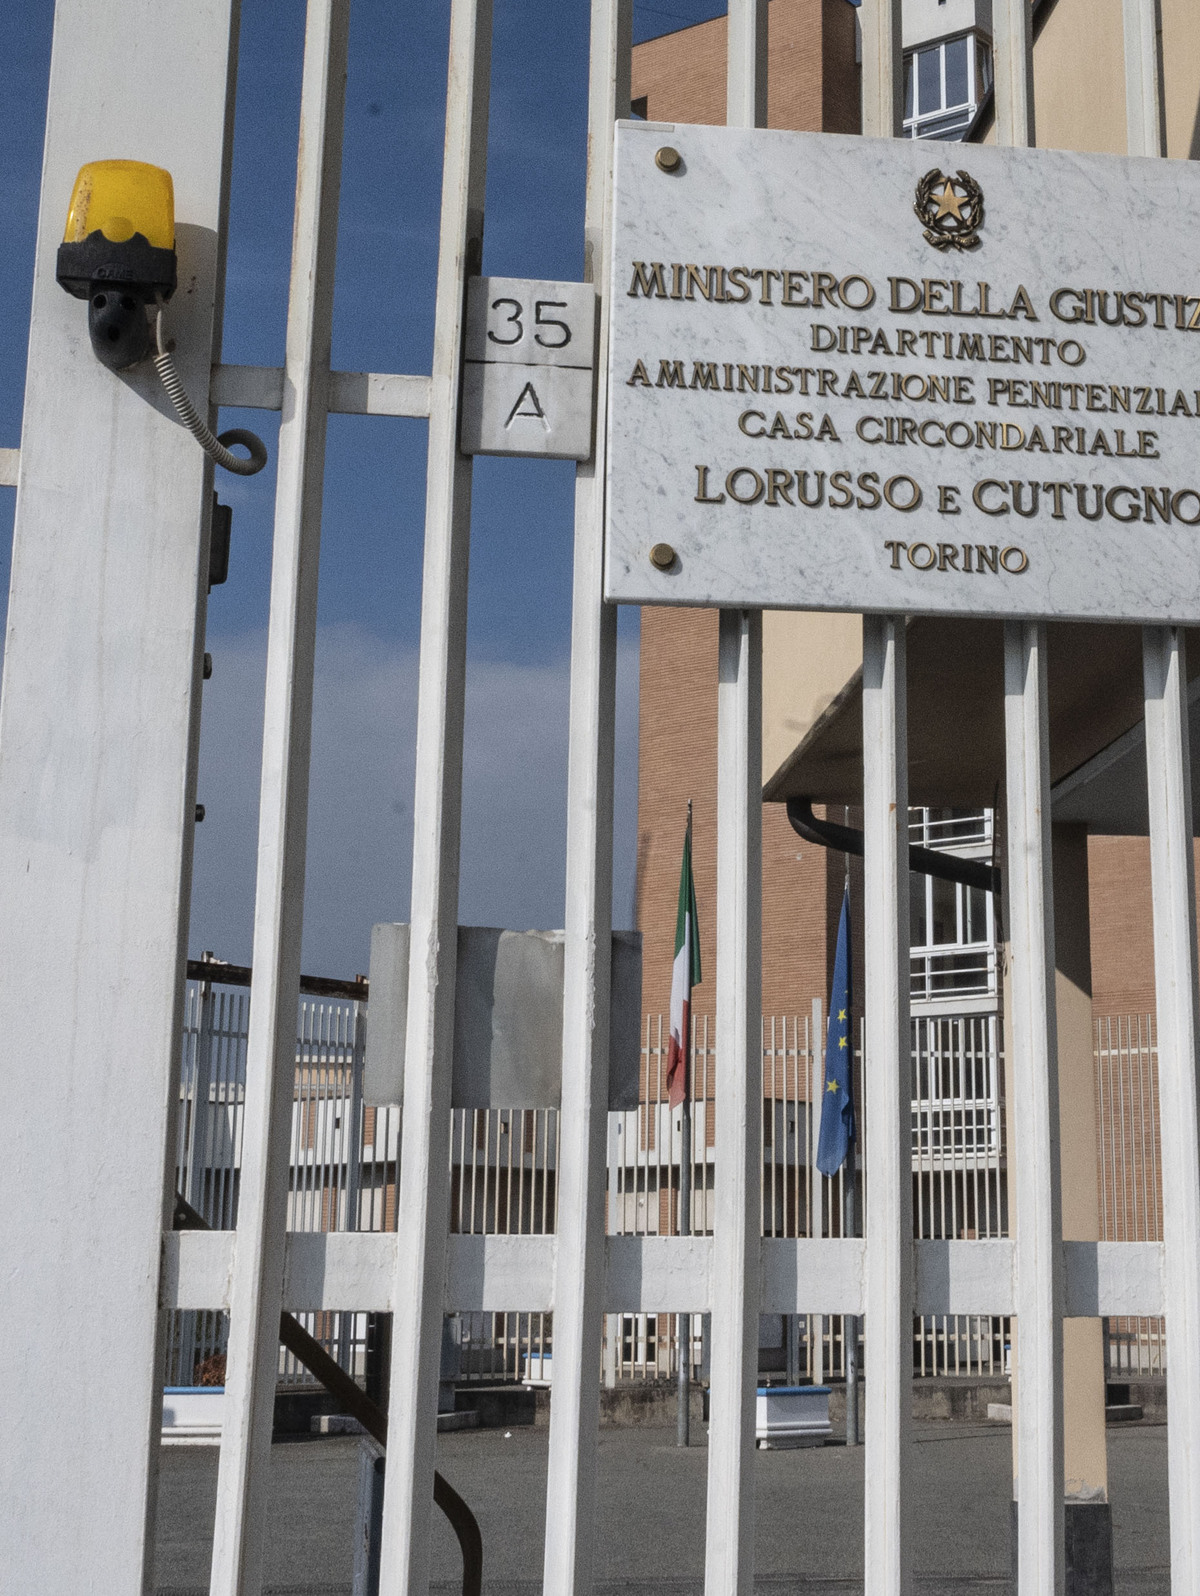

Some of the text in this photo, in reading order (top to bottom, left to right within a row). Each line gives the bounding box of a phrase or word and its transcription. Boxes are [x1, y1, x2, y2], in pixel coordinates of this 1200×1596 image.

[628, 261, 875, 311] MINISTERO
[887, 276, 1037, 321] DELLA
[488, 298, 572, 348] 35
[810, 323, 1086, 366] DIPARTIMENTO
[626, 358, 975, 403] AMMINISTRAZIONE
[504, 381, 551, 432] A
[738, 410, 1160, 458] CASA CIRCONDARIALE
[695, 465, 922, 513] LORUSSO
[938, 486, 962, 515] E
[885, 540, 1030, 574] TORINO
